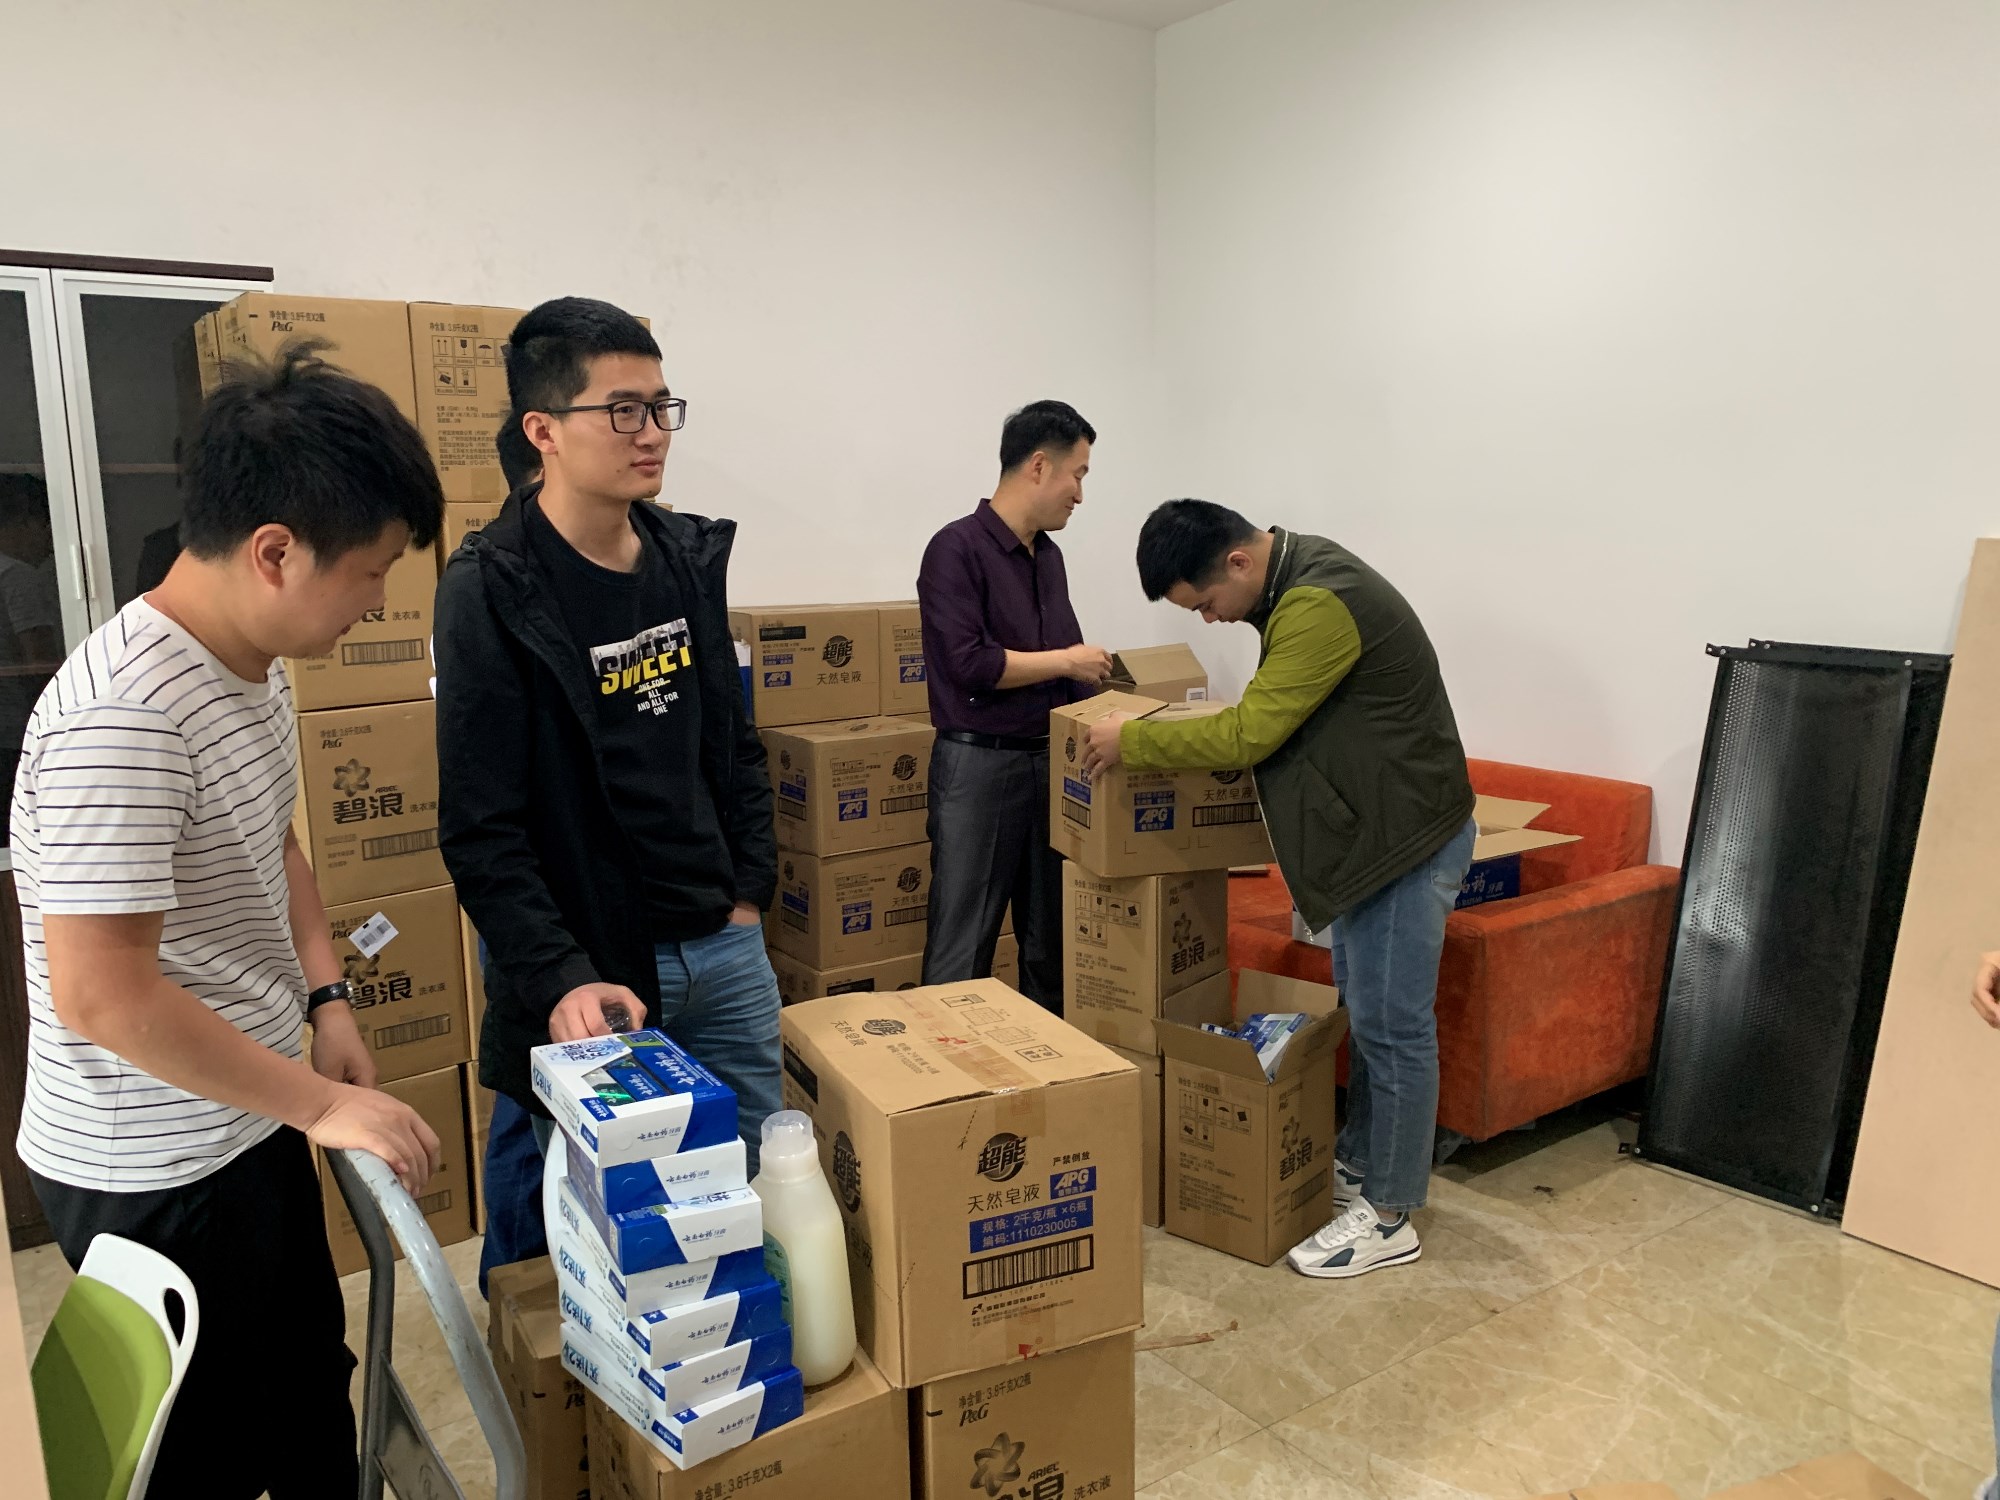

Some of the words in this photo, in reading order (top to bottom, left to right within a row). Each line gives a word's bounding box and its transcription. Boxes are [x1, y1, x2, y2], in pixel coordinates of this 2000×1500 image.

[271, 321, 293, 332] P&G
[392, 610, 421, 621] 洗衣液
[822, 639, 853, 661] 超能
[599, 629, 691, 695] SWEET
[766, 671, 787, 683] APG
[816, 670, 862, 686] 天然皂液
[903, 665, 922, 678] APG
[637, 701, 651, 712] AND
[651, 696, 664, 708] ALL
[664, 691, 679, 703] FOR
[648, 688, 661, 699] ALL
[653, 704, 668, 716] ONE
[322, 738, 343, 749] P&G
[888, 781, 924, 795] 天然皂液
[1203, 787, 1253, 802] 天然皂液
[333, 793, 404, 824] 碧浪
[842, 801, 863, 815] APG
[1138, 807, 1168, 823] APG
[845, 914, 867, 928] APG
[1171, 941, 1205, 975] 碧浪
[419, 982, 447, 996] 洗衣液
[976, 1136, 1028, 1175] 超能
[1280, 1140, 1312, 1182] 碧浪
[1054, 1168, 1089, 1190] APG
[968, 1184, 1040, 1214] 天然皂液
[983, 1219, 1009, 1233] 规格:
[1014, 1207, 1057, 1226] 2千克/瓶
[983, 1217, 1078, 1248] 编码:1110230005
[959, 1402, 989, 1427] P&G
[1028, 1463, 1059, 1482] ARIEL
[1074, 1474, 1112, 1500] 洗衣液
